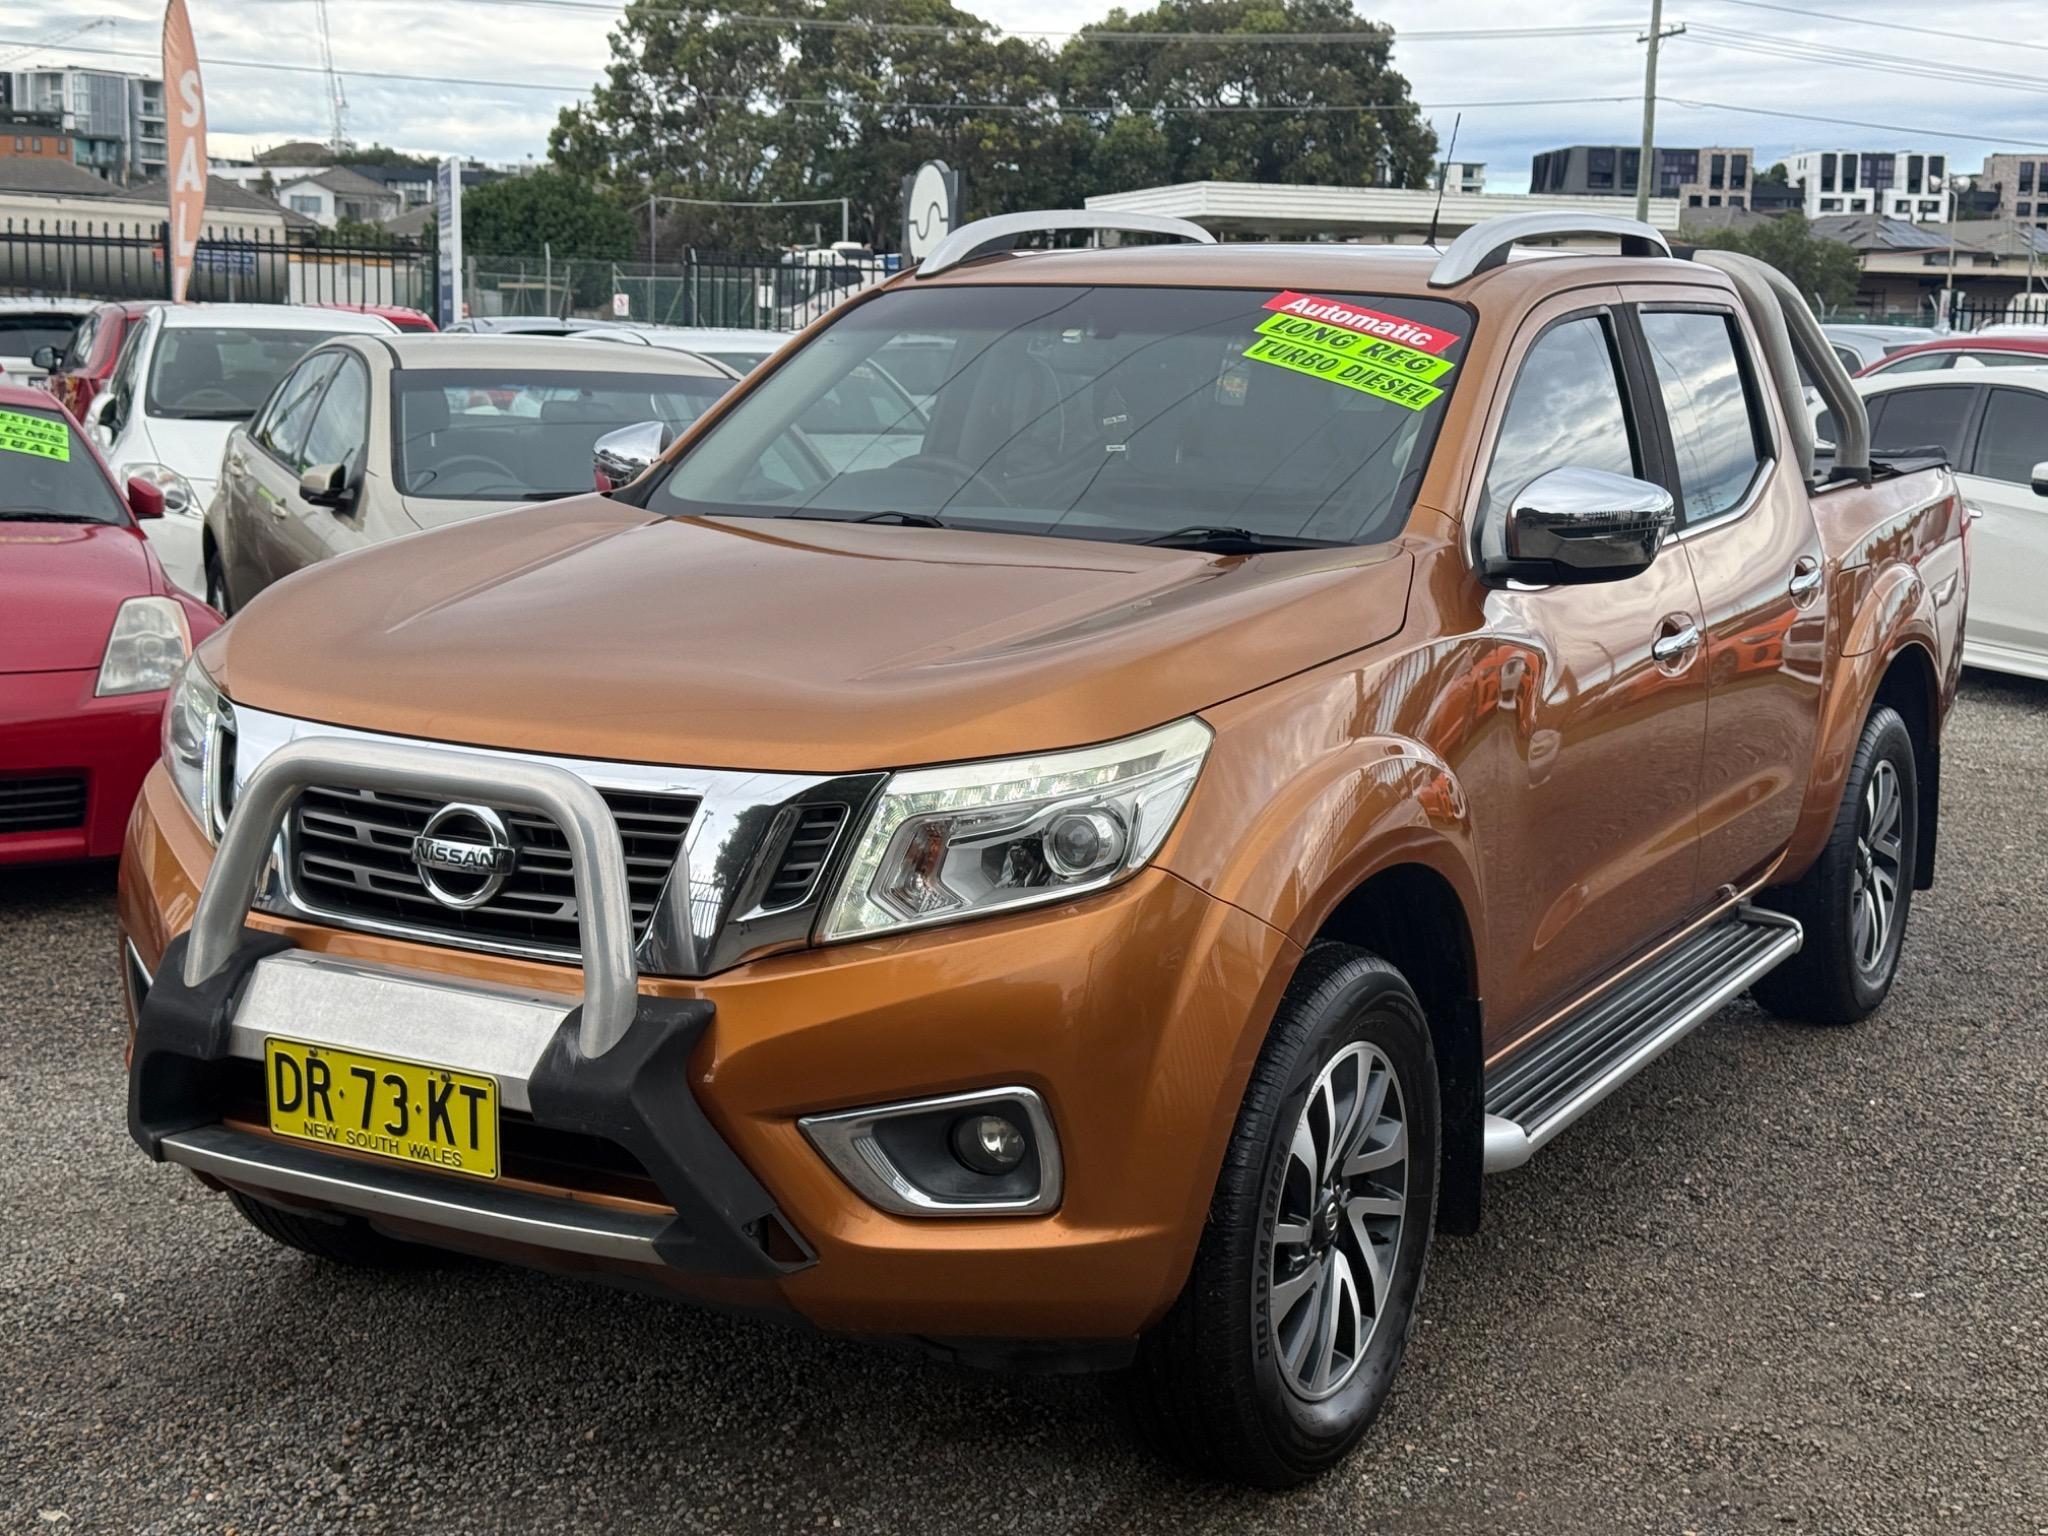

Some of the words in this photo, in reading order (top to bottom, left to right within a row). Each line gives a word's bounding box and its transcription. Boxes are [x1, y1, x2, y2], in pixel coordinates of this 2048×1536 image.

[1269, 317, 1358, 349] LONG
[1360, 341, 1438, 375] REG
[1280, 298, 1434, 347] Automatic
[1250, 338, 1342, 372] TURBO
[1336, 363, 1434, 407] DIESEL
[415, 839, 499, 871] NISSAN
[303, 1120, 338, 1140] NEW
[345, 1129, 400, 1155] SOUTH
[407, 1141, 463, 1168] WALES
[1256, 1141, 1288, 1361] ROADMARCH
